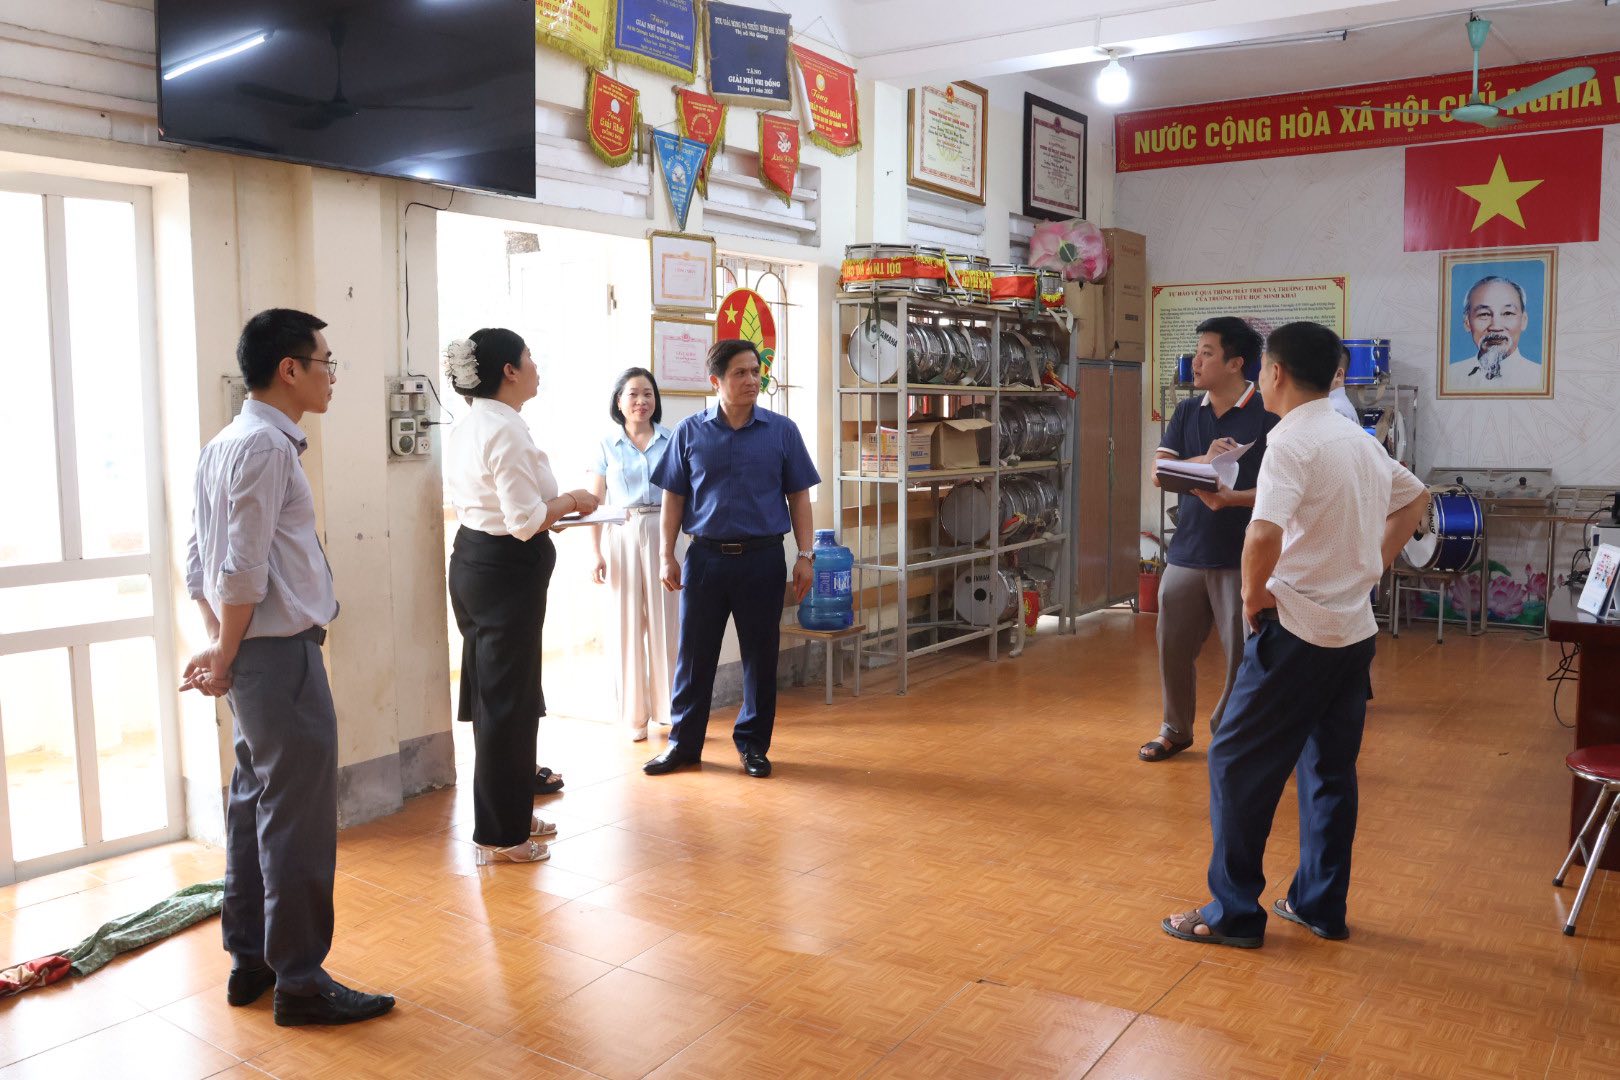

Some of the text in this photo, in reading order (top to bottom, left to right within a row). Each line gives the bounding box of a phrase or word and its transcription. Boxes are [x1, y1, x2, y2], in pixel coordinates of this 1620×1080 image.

[728, 74, 743, 84] GIẢI
[811, 88, 828, 103] Tặng
[1134, 121, 1197, 154] NƯỚC
[1205, 115, 1271, 151] CỘNG
[1280, 106, 1331, 139] HÒA
[1339, 100, 1375, 133] XÃ
[1384, 95, 1429, 132] HỘI
